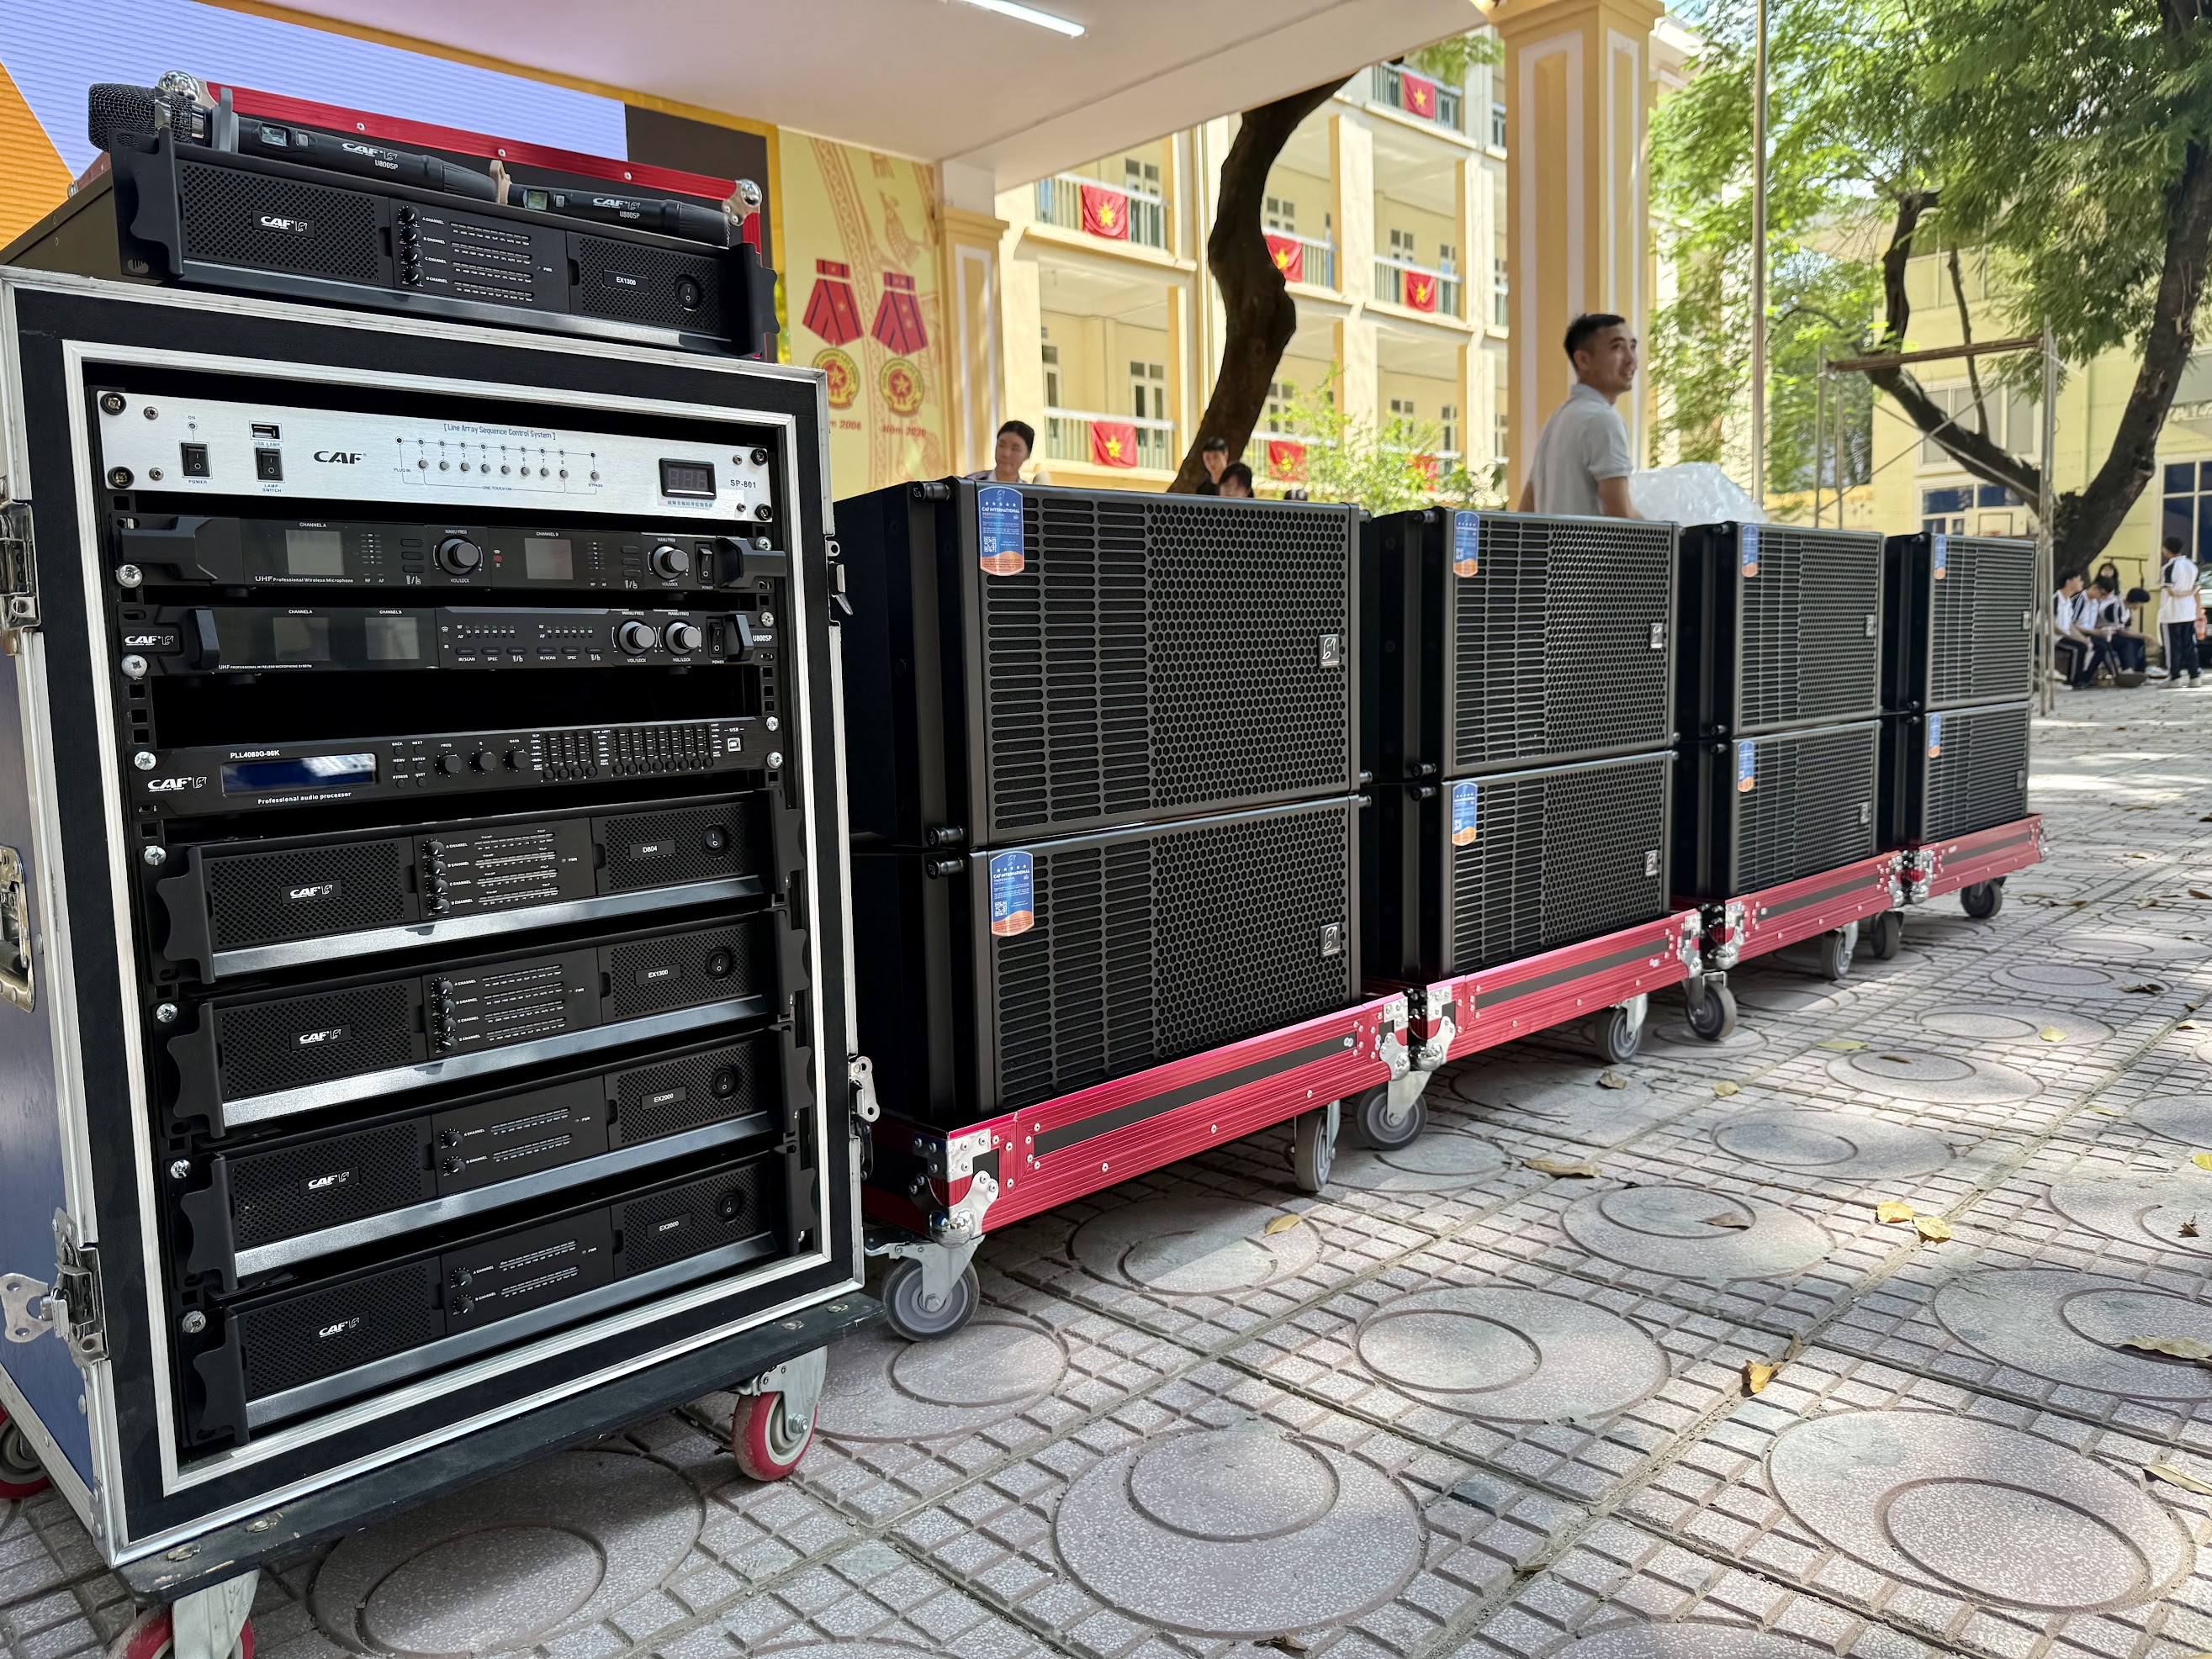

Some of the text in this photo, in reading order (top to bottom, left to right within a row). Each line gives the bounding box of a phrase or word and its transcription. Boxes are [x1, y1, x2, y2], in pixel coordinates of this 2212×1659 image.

[341, 143, 380, 156] CAF
[375, 159, 399, 170] U800SP
[593, 198, 625, 208] CAF
[620, 211, 640, 219] U800SP
[261, 216, 292, 229] CAF
[616, 276, 637, 286] EX1300
[462, 425, 478, 434] Array
[479, 426, 508, 436] Sequence
[509, 429, 530, 437] Control
[314, 451, 362, 464] CAF
[730, 479, 756, 489] SP-801
[124, 636, 158, 644] CAF
[147, 778, 188, 790] CAF
[257, 795, 299, 805] Professional
[320, 792, 352, 800] processor
[1001, 869, 1030, 878] INTERNATIONAL
[290, 886, 318, 897] CAF
[648, 970, 669, 978] EX1300
[299, 1032, 326, 1042] CAF
[654, 1093, 674, 1103] EX2000
[308, 1176, 335, 1187] CAF
[659, 1221, 680, 1232] EX2000
[476, 1265, 495, 1274] CHANNEL
[479, 1292, 496, 1300] CHANNEL
[319, 1323, 346, 1335] CAF
